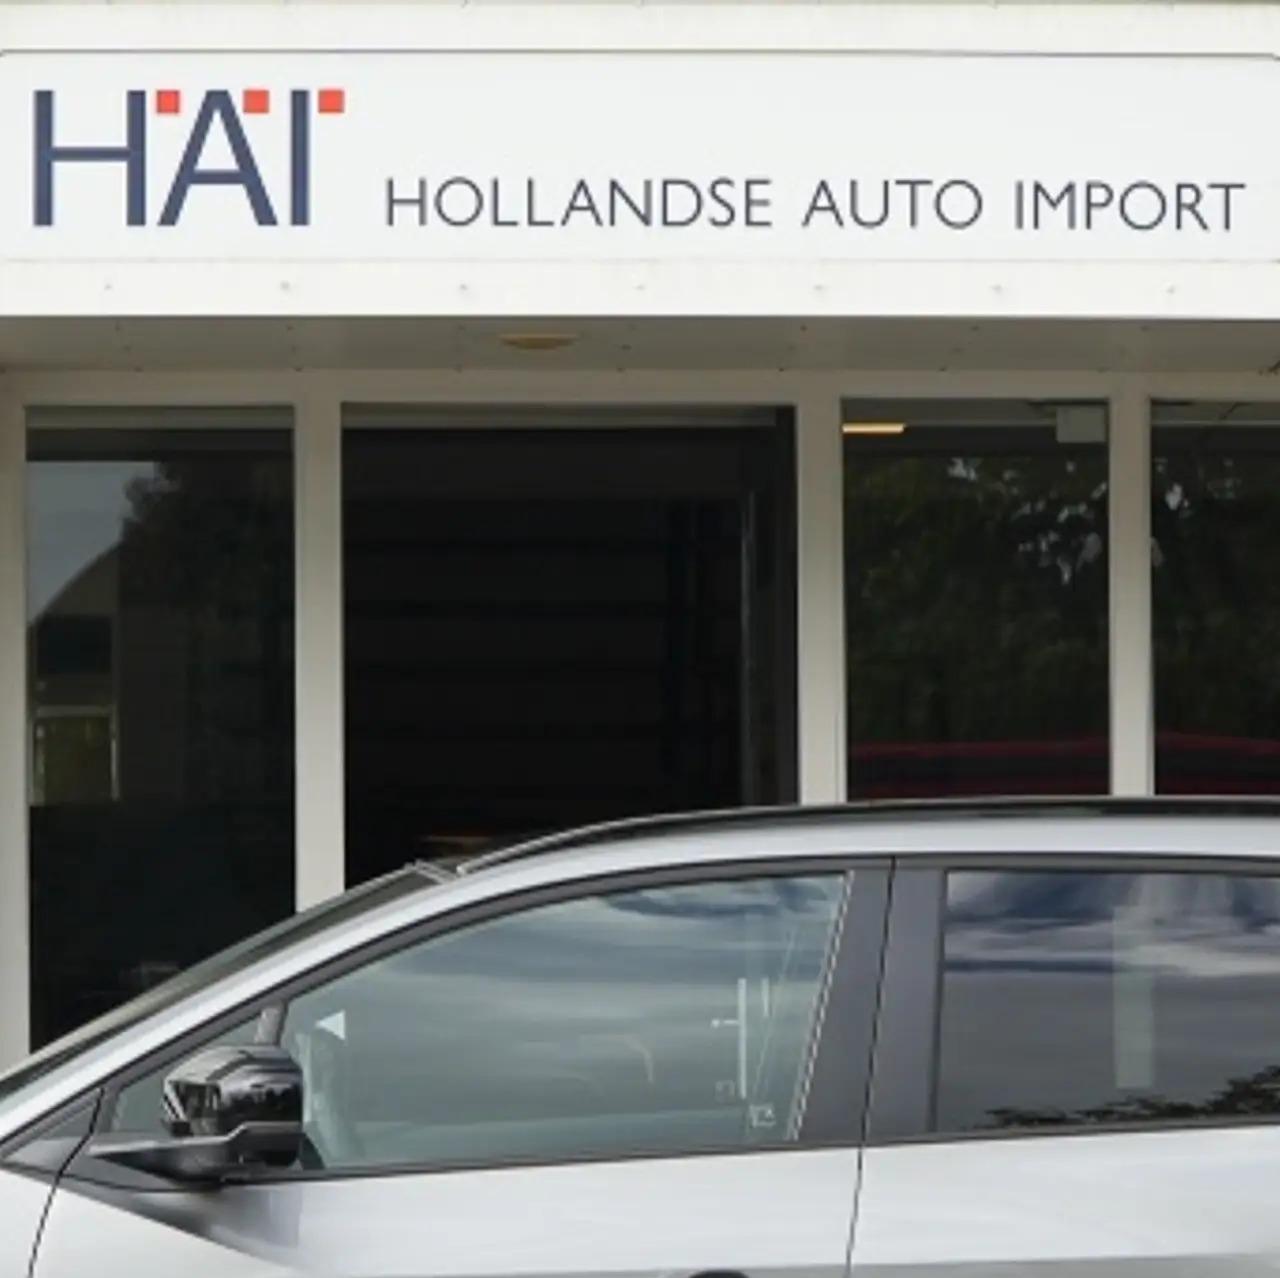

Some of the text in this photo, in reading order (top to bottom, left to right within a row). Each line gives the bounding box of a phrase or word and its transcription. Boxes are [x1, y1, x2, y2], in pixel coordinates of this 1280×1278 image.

[34, 90, 343, 227] HAI
[387, 176, 1246, 231] HOLLANDSE AUTO IMPORT
